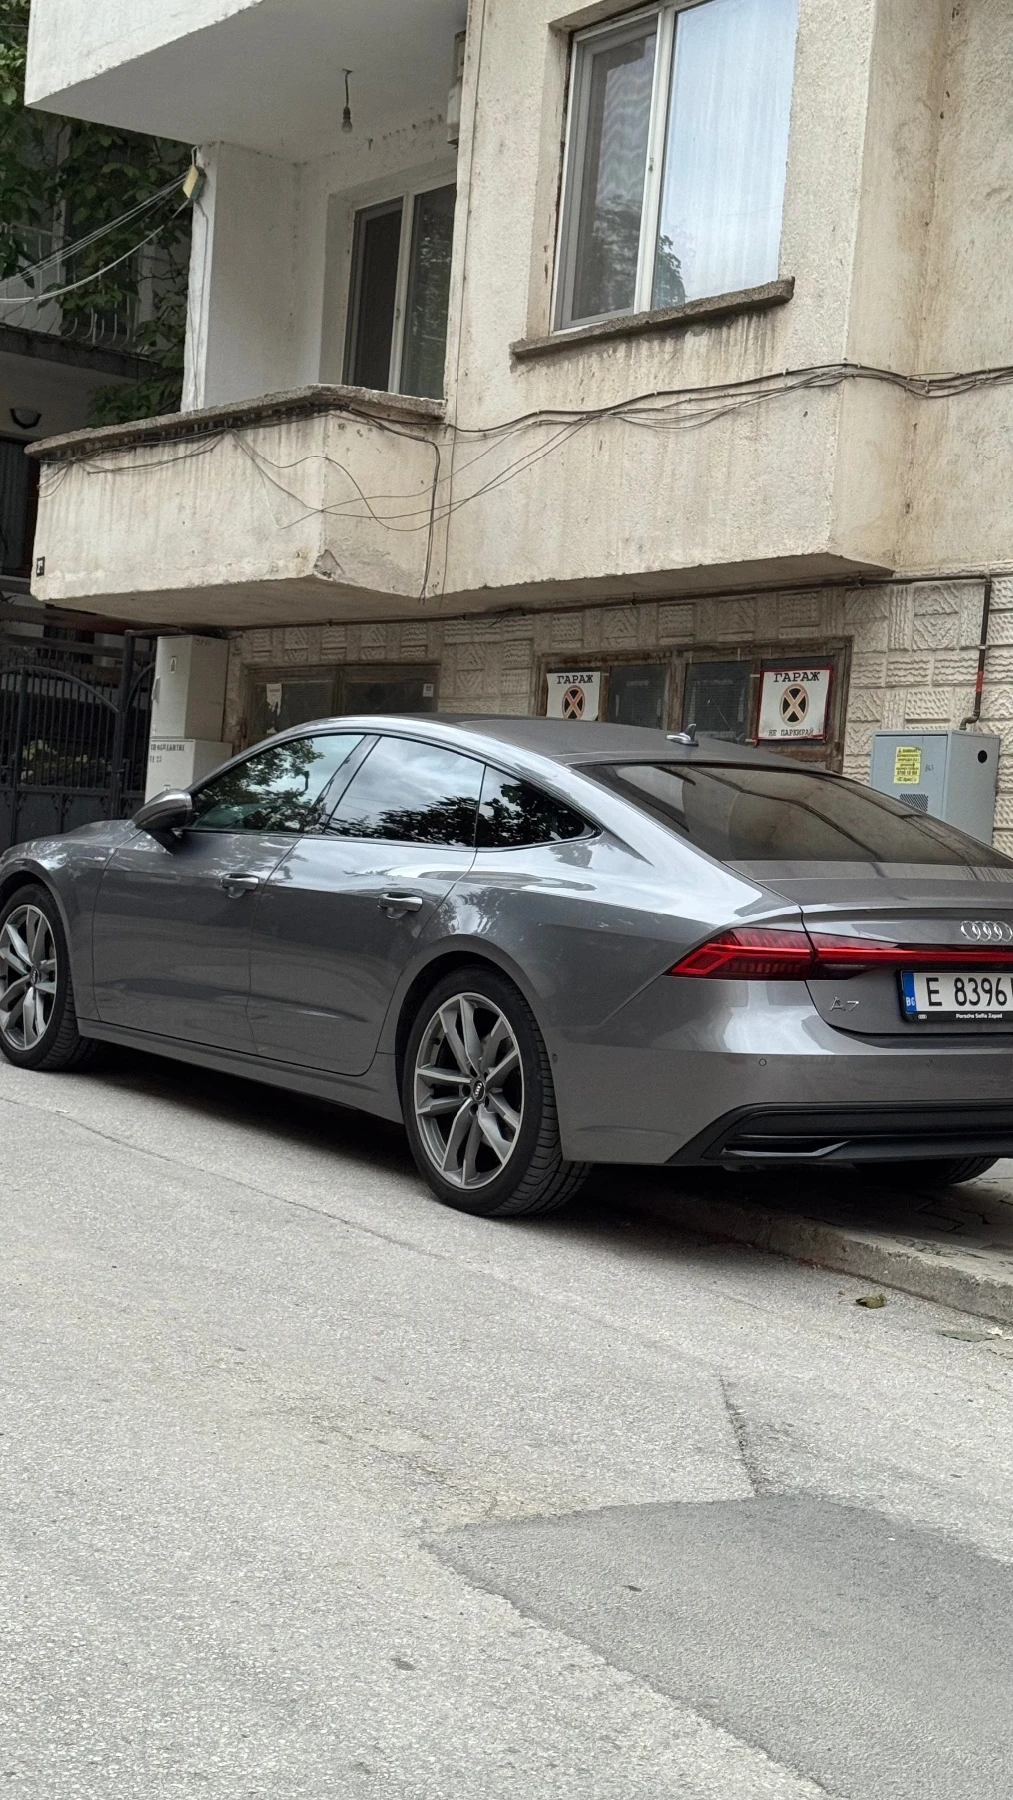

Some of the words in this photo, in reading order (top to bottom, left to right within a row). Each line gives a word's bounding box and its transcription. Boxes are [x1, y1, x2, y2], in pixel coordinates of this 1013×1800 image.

[556, 674, 594, 685] ГАРАЖ
[773, 671, 821, 683] ГАРАЖ
[768, 729, 778, 737] НЕ
[780, 727, 814, 737] ПАРКИРАЙ
[925, 977, 943, 1007] E
[953, 977, 1008, 1007] 8396
[829, 996, 860, 1011] A7
[905, 996, 916, 1007] BG
